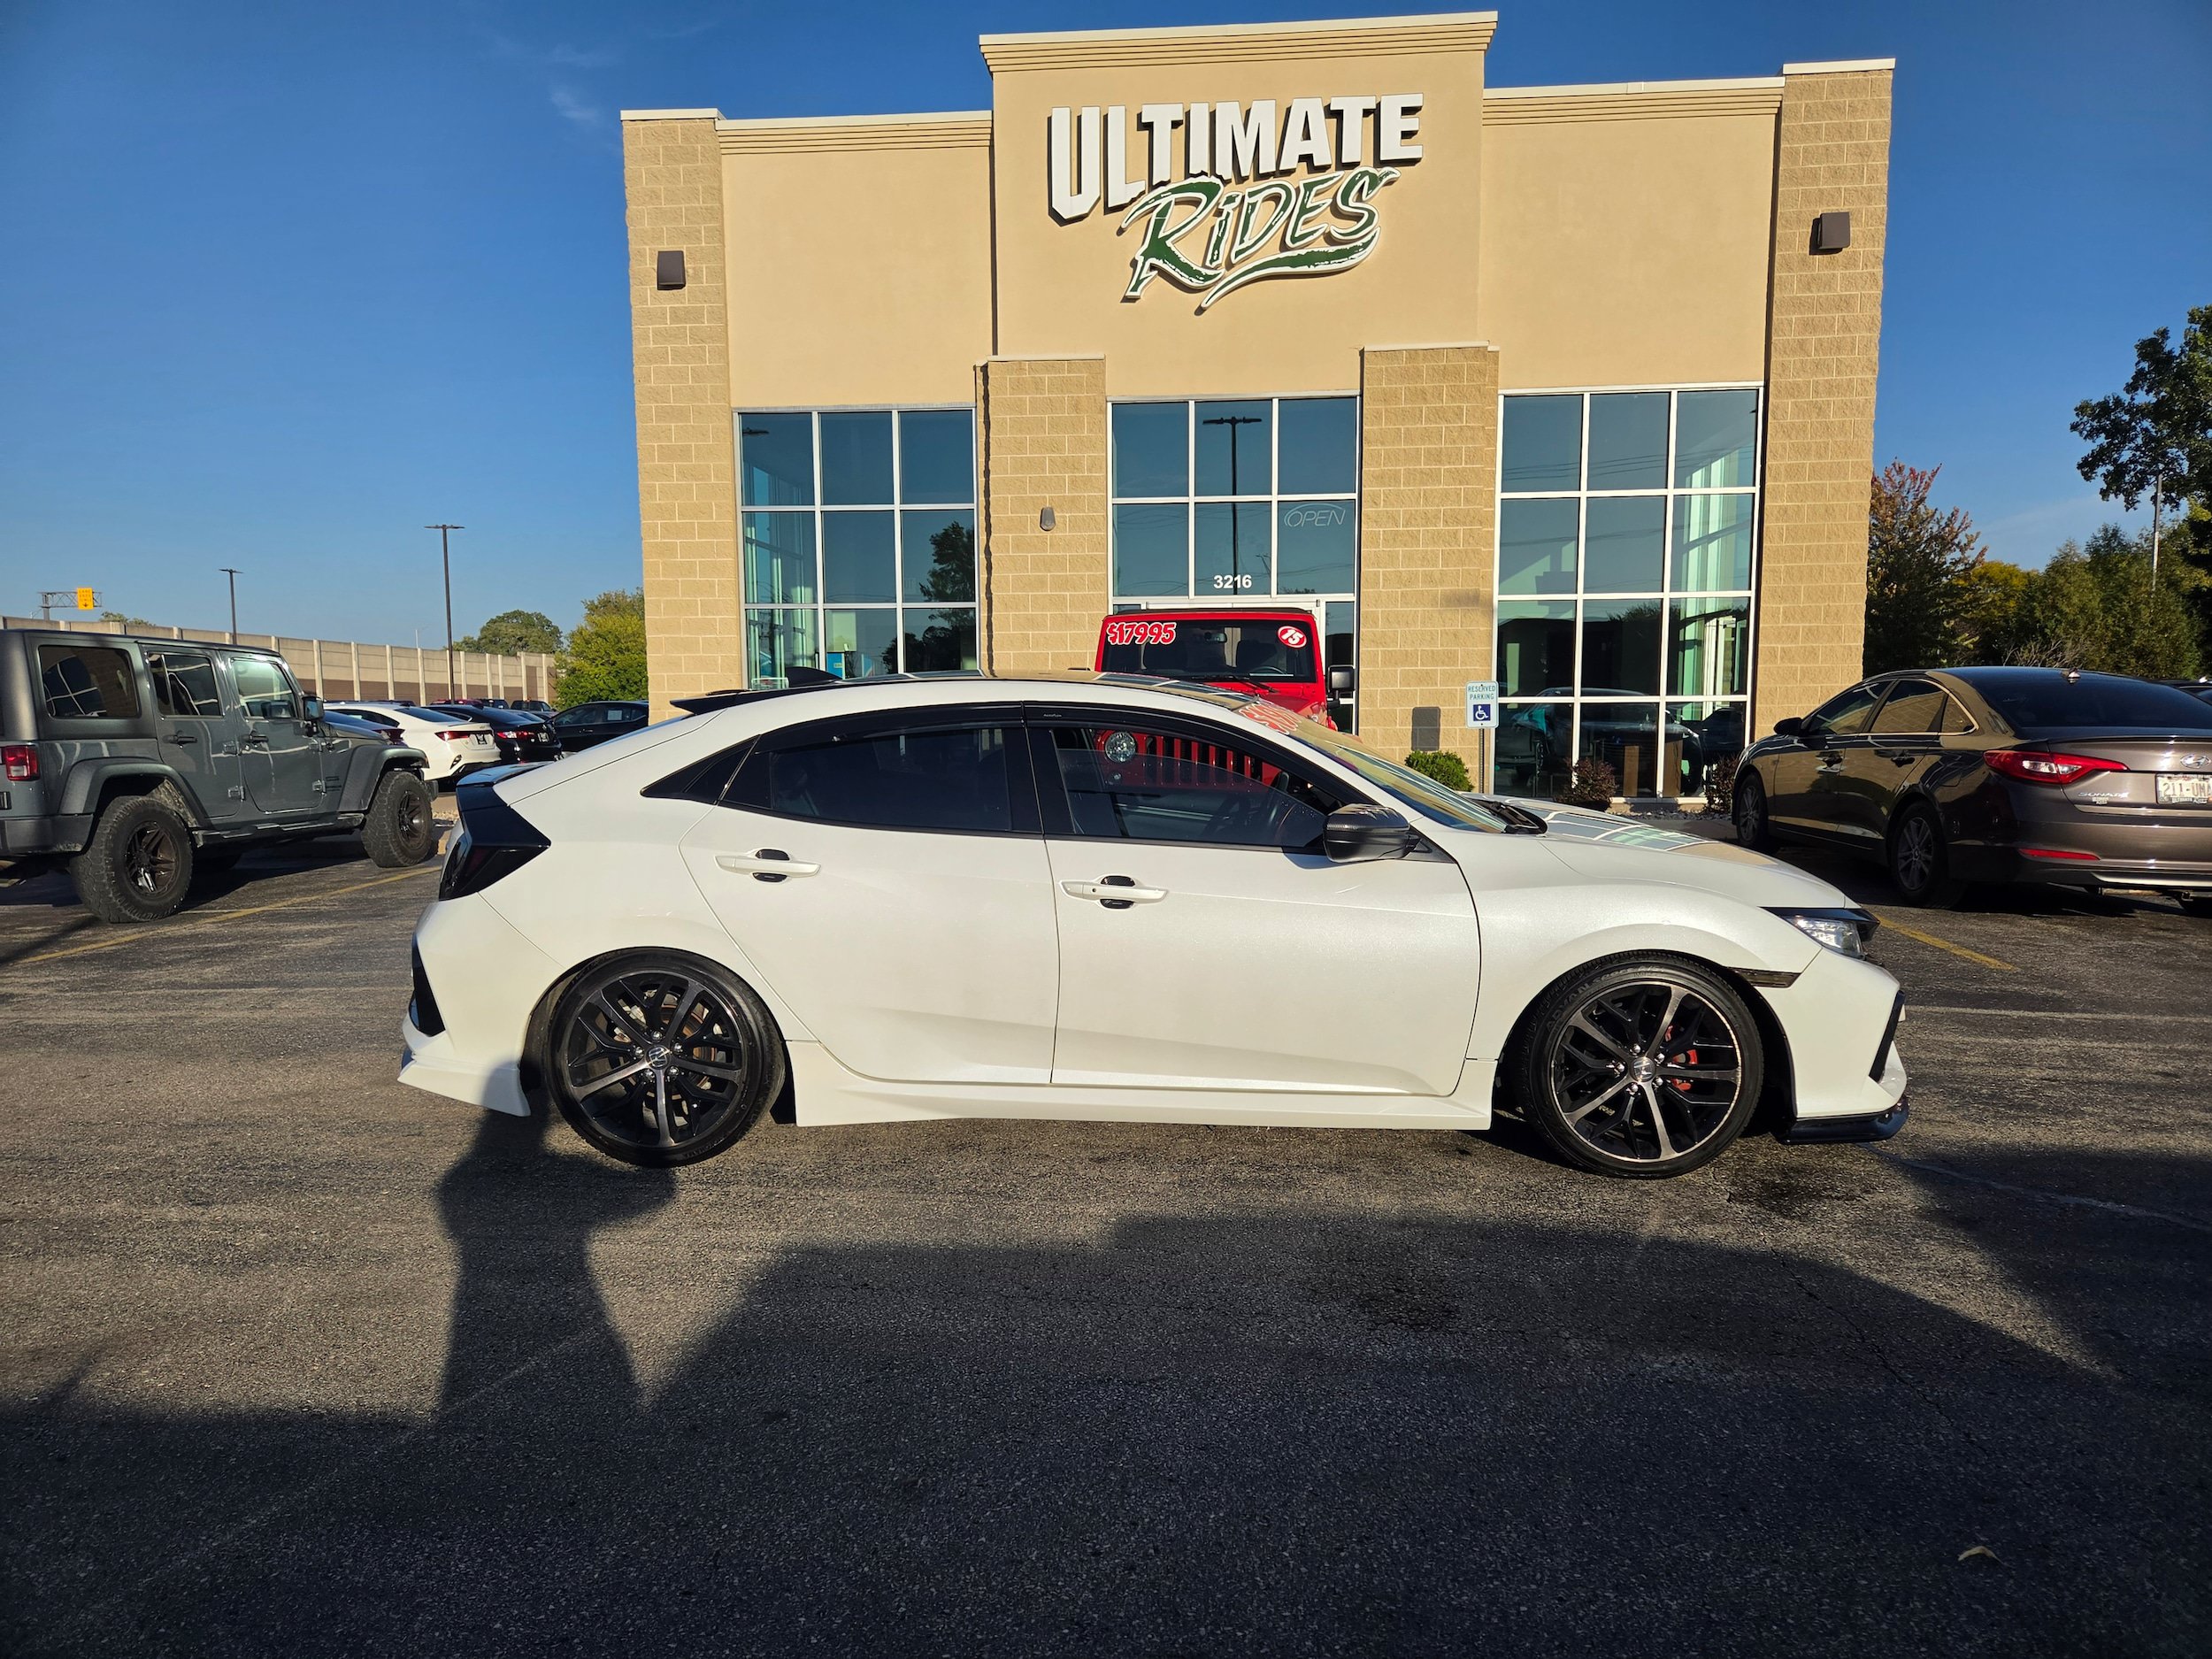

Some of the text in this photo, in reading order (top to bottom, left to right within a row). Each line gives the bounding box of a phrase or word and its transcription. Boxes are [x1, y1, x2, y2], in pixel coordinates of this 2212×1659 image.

[1048, 93, 1423, 221] ULTIMATE
[1286, 509, 1346, 527] OPEN
[1213, 575, 1253, 589] 3216
[1107, 622, 1177, 645] $17995
[1280, 628, 1304, 645] 15
